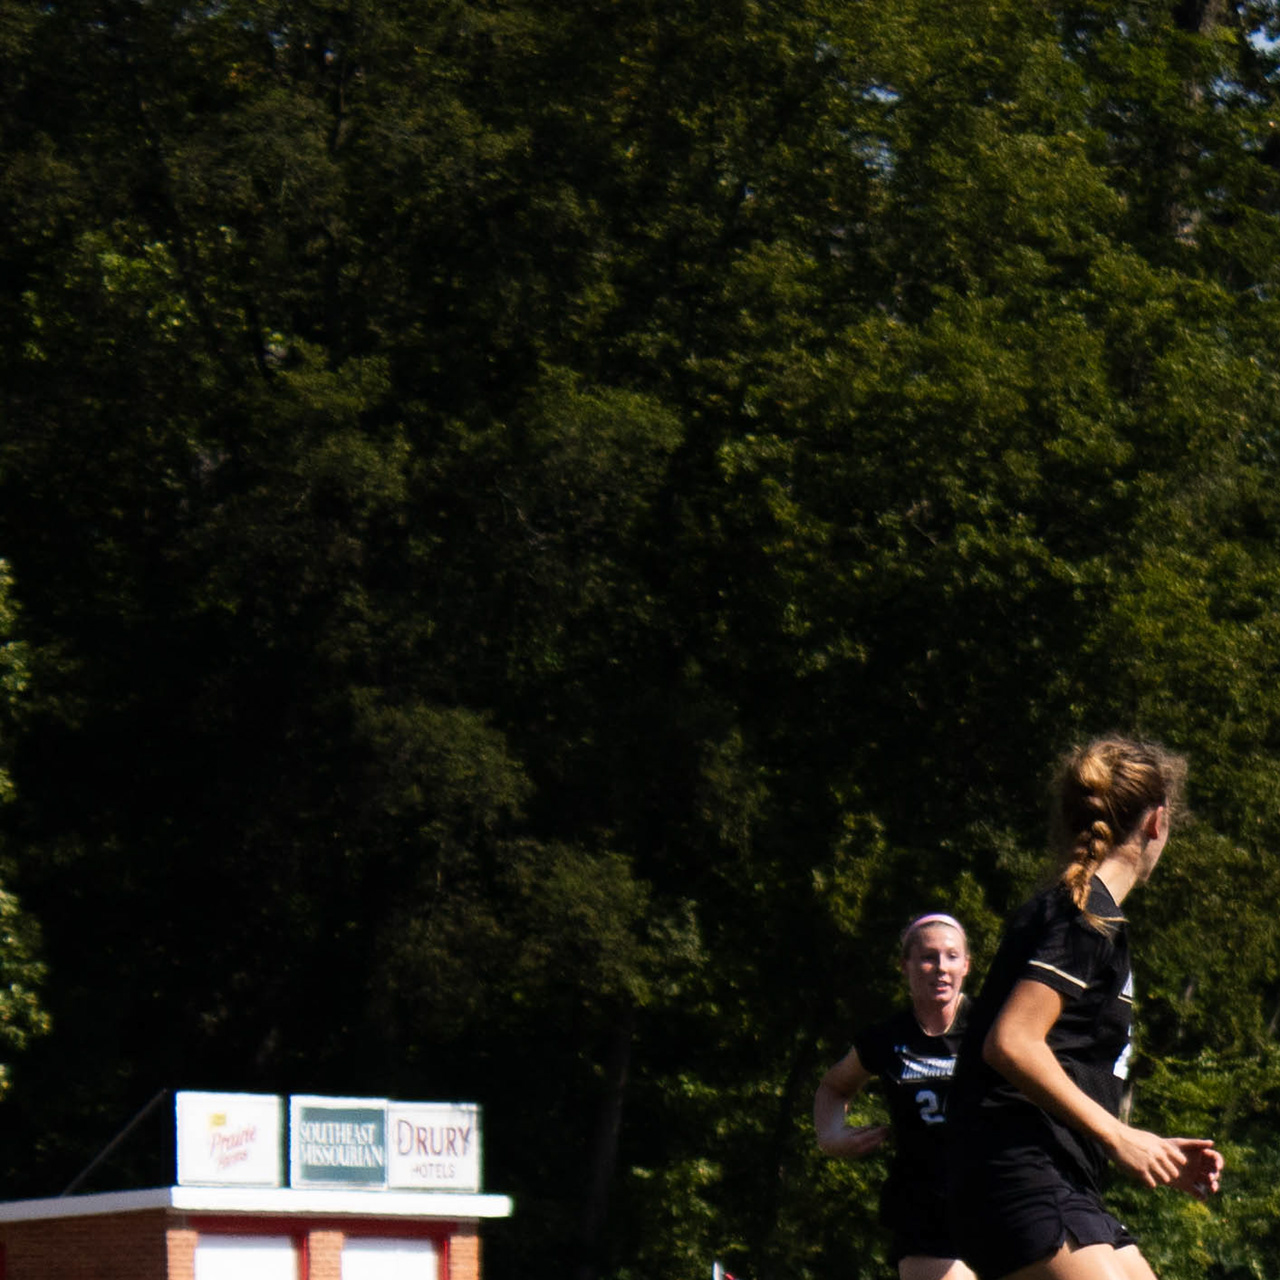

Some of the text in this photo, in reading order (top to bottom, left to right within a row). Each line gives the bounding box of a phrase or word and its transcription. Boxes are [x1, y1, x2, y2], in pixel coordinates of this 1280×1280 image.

[301, 1121, 376, 1144] SOUTHEAST
[397, 1118, 471, 1157] DRURY
[301, 1143, 384, 1168] MISSOURIAN
